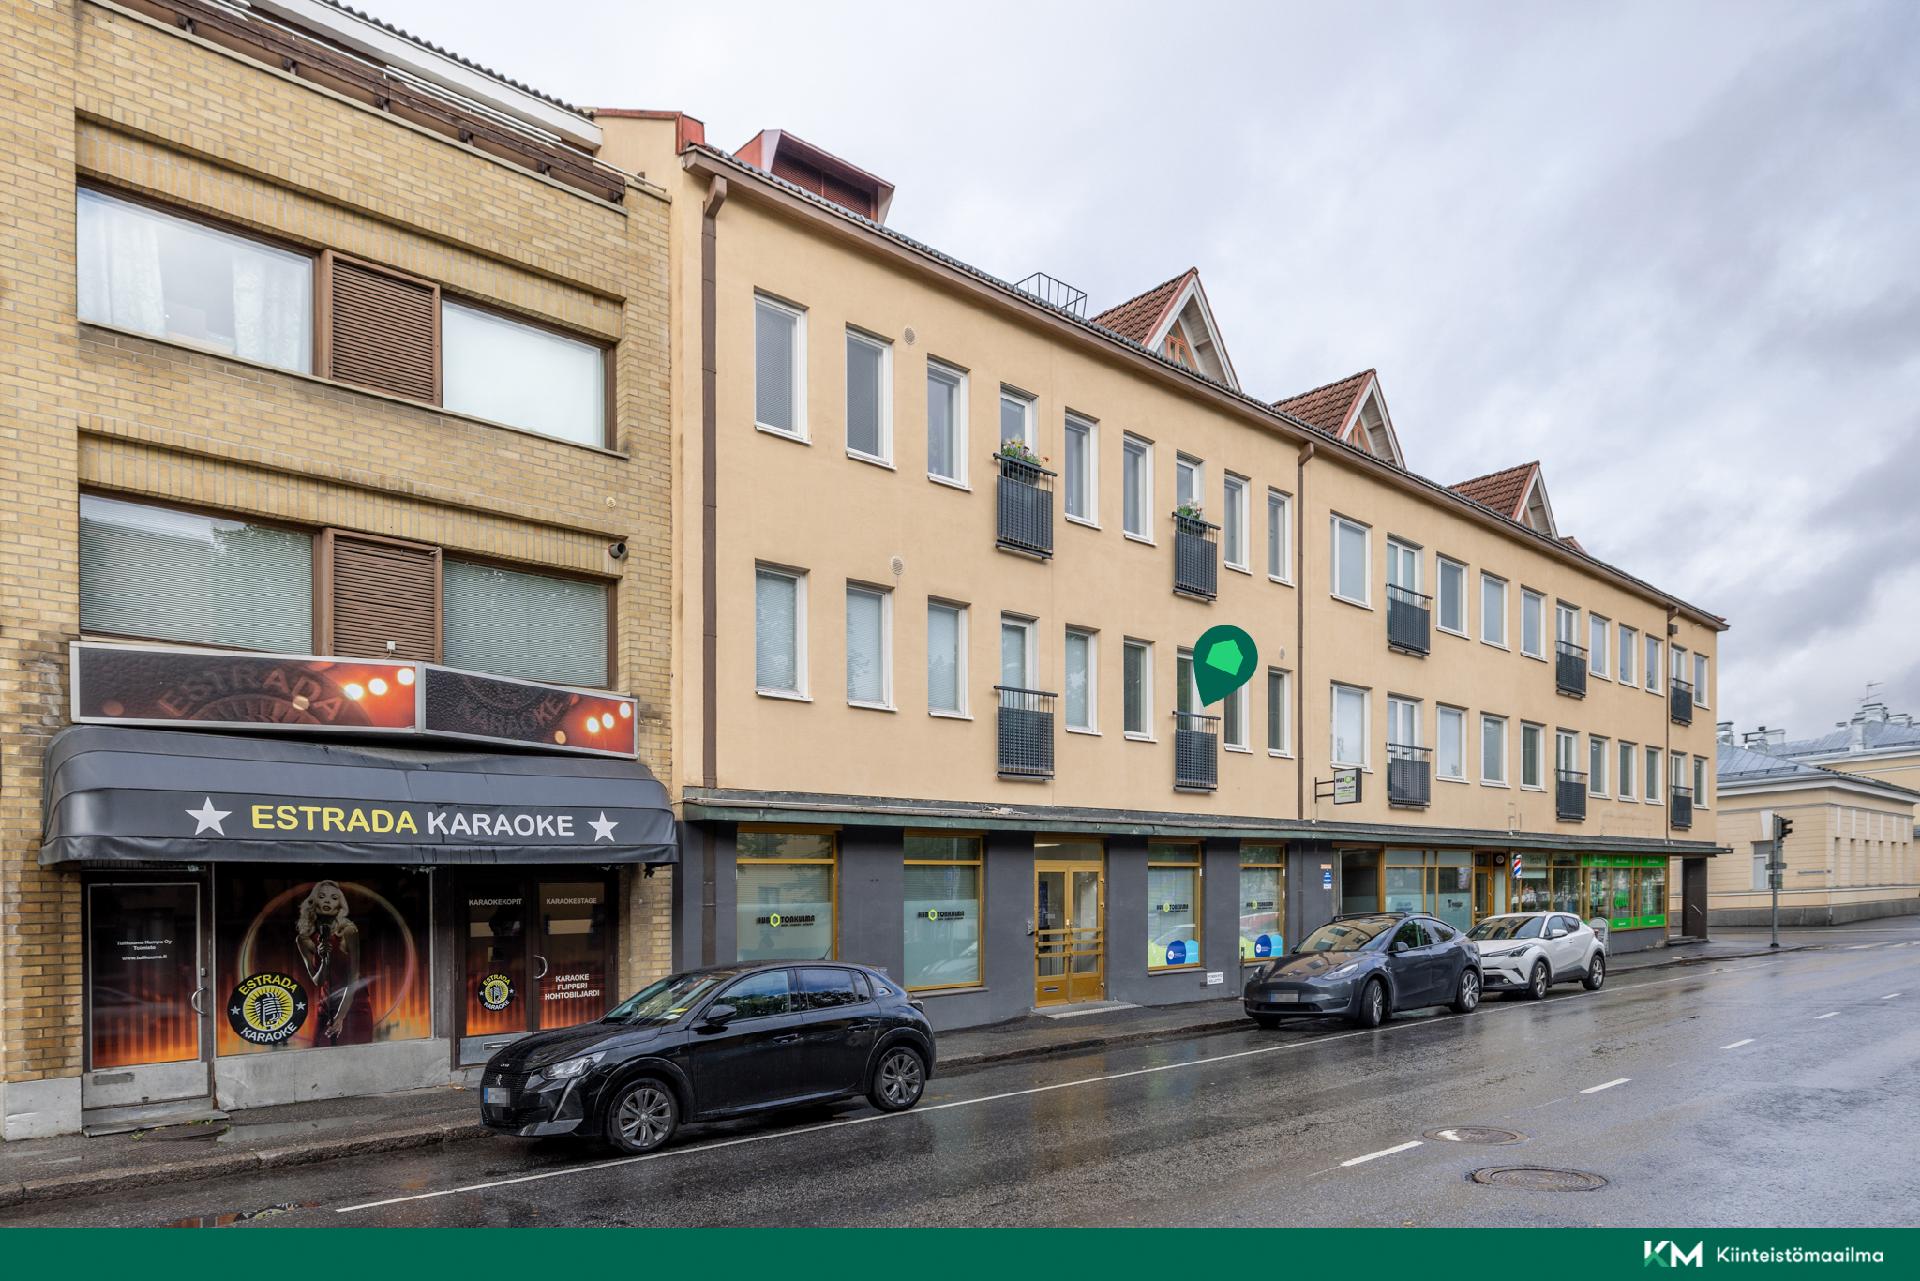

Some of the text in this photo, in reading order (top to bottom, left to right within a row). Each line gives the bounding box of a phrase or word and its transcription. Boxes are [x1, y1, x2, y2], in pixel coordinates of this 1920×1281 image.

[159, 664, 344, 721] ESTRADA
[251, 805, 575, 838] ESTRADA KARAOKE
[468, 898, 522, 906] KARAOKEKOPIT
[546, 897, 597, 905] KARAOKESTAGE
[483, 974, 511, 986] ESTRADA
[555, 973, 590, 982] KARAOKE
[239, 974, 298, 996] ESTRADA
[557, 982, 588, 990] FLIPPERI
[544, 990, 600, 1000] HOHTOBILJARDI
[484, 1000, 511, 1011] KARAOKE
[240, 1022, 298, 1043] KARAOKE
